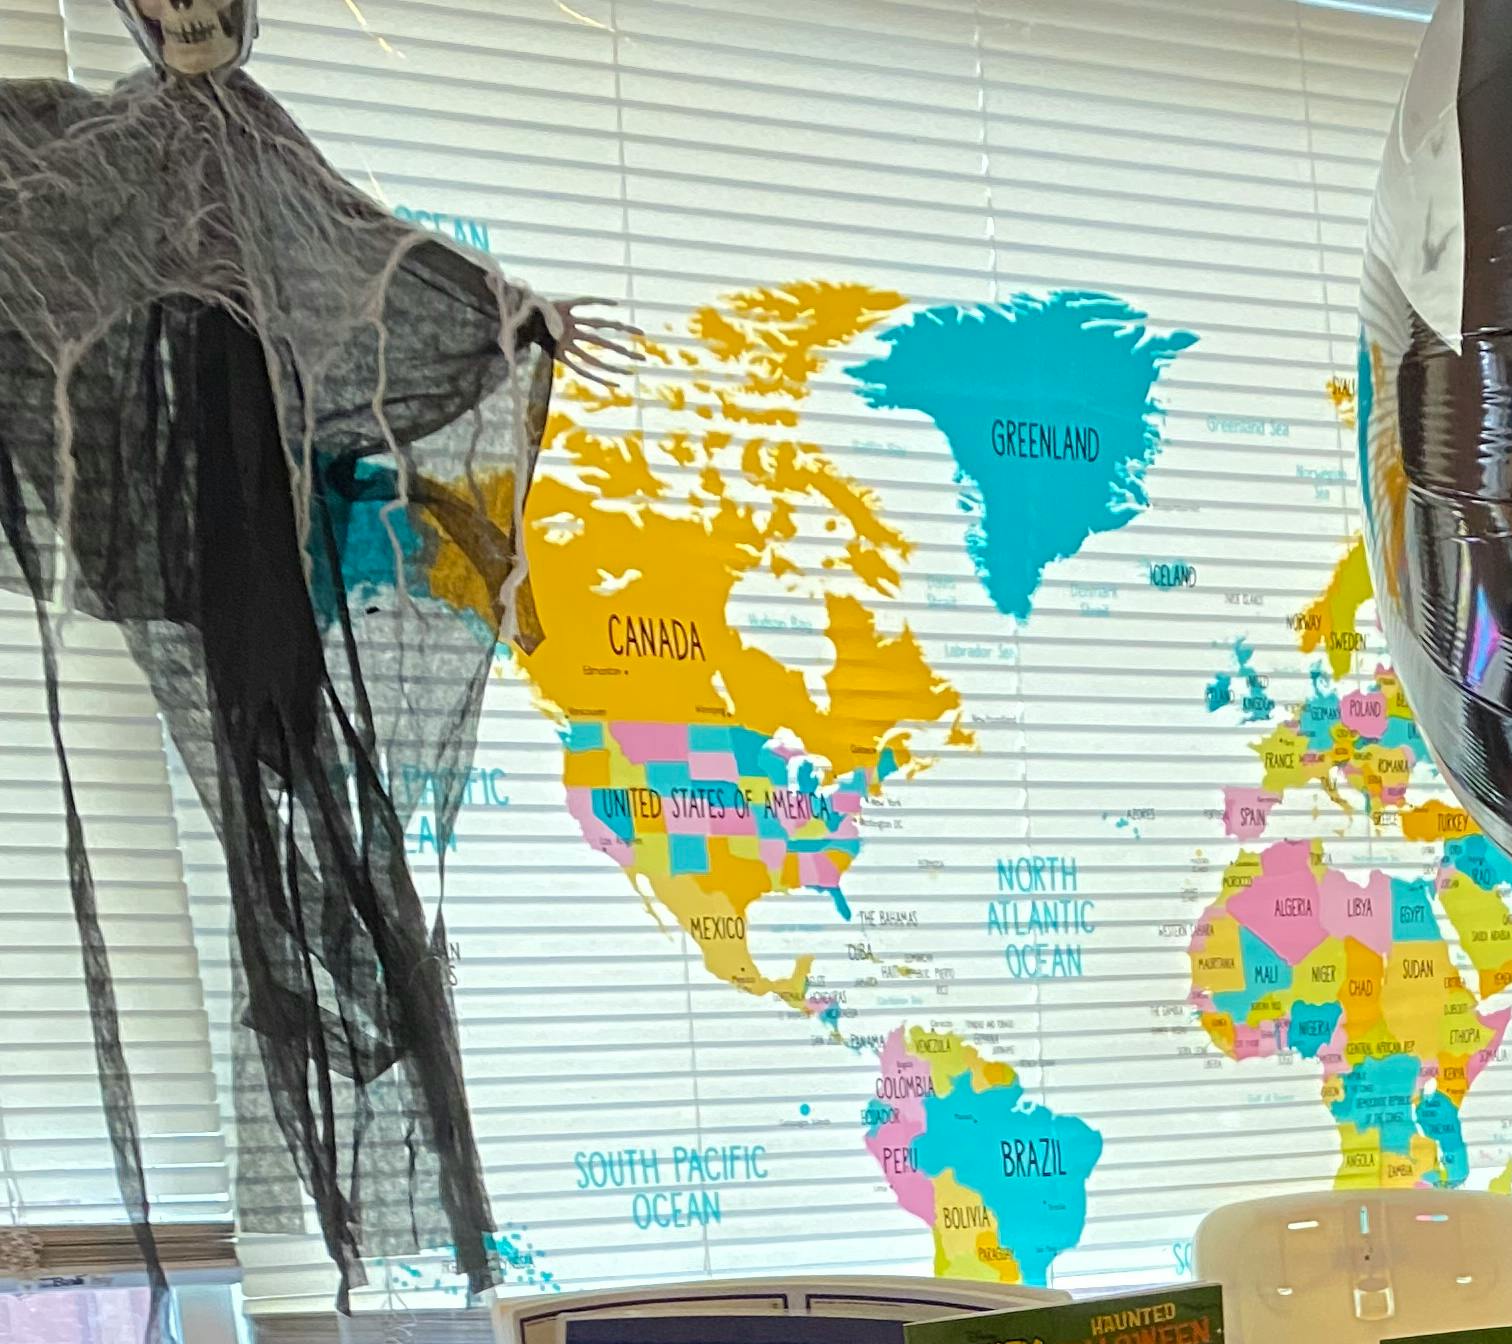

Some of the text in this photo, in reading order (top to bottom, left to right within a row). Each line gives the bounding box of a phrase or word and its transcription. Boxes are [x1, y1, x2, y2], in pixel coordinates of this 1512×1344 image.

[991, 419, 1100, 462] GREENLAND
[1150, 564, 1197, 588] ICELAND
[1286, 615, 1322, 631] NORWAY
[608, 613, 706, 662] CANADA
[1330, 632, 1367, 651] SWEDEN
[1350, 700, 1381, 718] POLAND
[1265, 752, 1294, 769] FRANCE
[1378, 758, 1409, 773] ROMANIA
[602, 788, 833, 821] UNITED STATES OF AMERICA
[1240, 808, 1266, 826] SPAIN
[1373, 811, 1398, 826] GREECE
[1438, 814, 1469, 832] TURKEY
[996, 856, 1078, 893] NORTH
[1274, 899, 1313, 917] ALGERIA
[1347, 899, 1373, 917] LIBYA
[1400, 906, 1425, 923] EGYPT
[987, 899, 1096, 936] ATLANTIC
[690, 916, 745, 940] MEXICO
[846, 943, 873, 960] CUBA
[1005, 943, 1083, 978] OCEAN
[1255, 966, 1278, 983] MALI
[1311, 965, 1336, 983] NIGER
[1402, 958, 1434, 979] SUDAN
[1349, 979, 1373, 997] CHAD
[1449, 1030, 1481, 1045] ETHIOPIA
[875, 1077, 935, 1099] COLOMBIA
[861, 1108, 900, 1125] ECUADOR
[573, 1144, 769, 1189] SOUTH PACIFIC
[882, 1146, 919, 1174] PERU
[1000, 1137, 1068, 1178] BRAZIL
[1344, 1153, 1375, 1168] ANGOLA
[1387, 1164, 1413, 1178] ZAMBIA
[631, 1191, 722, 1230] OCEAN
[942, 1205, 991, 1229] BOLIVIA
[1091, 1302, 1176, 1335] HAUNTED
